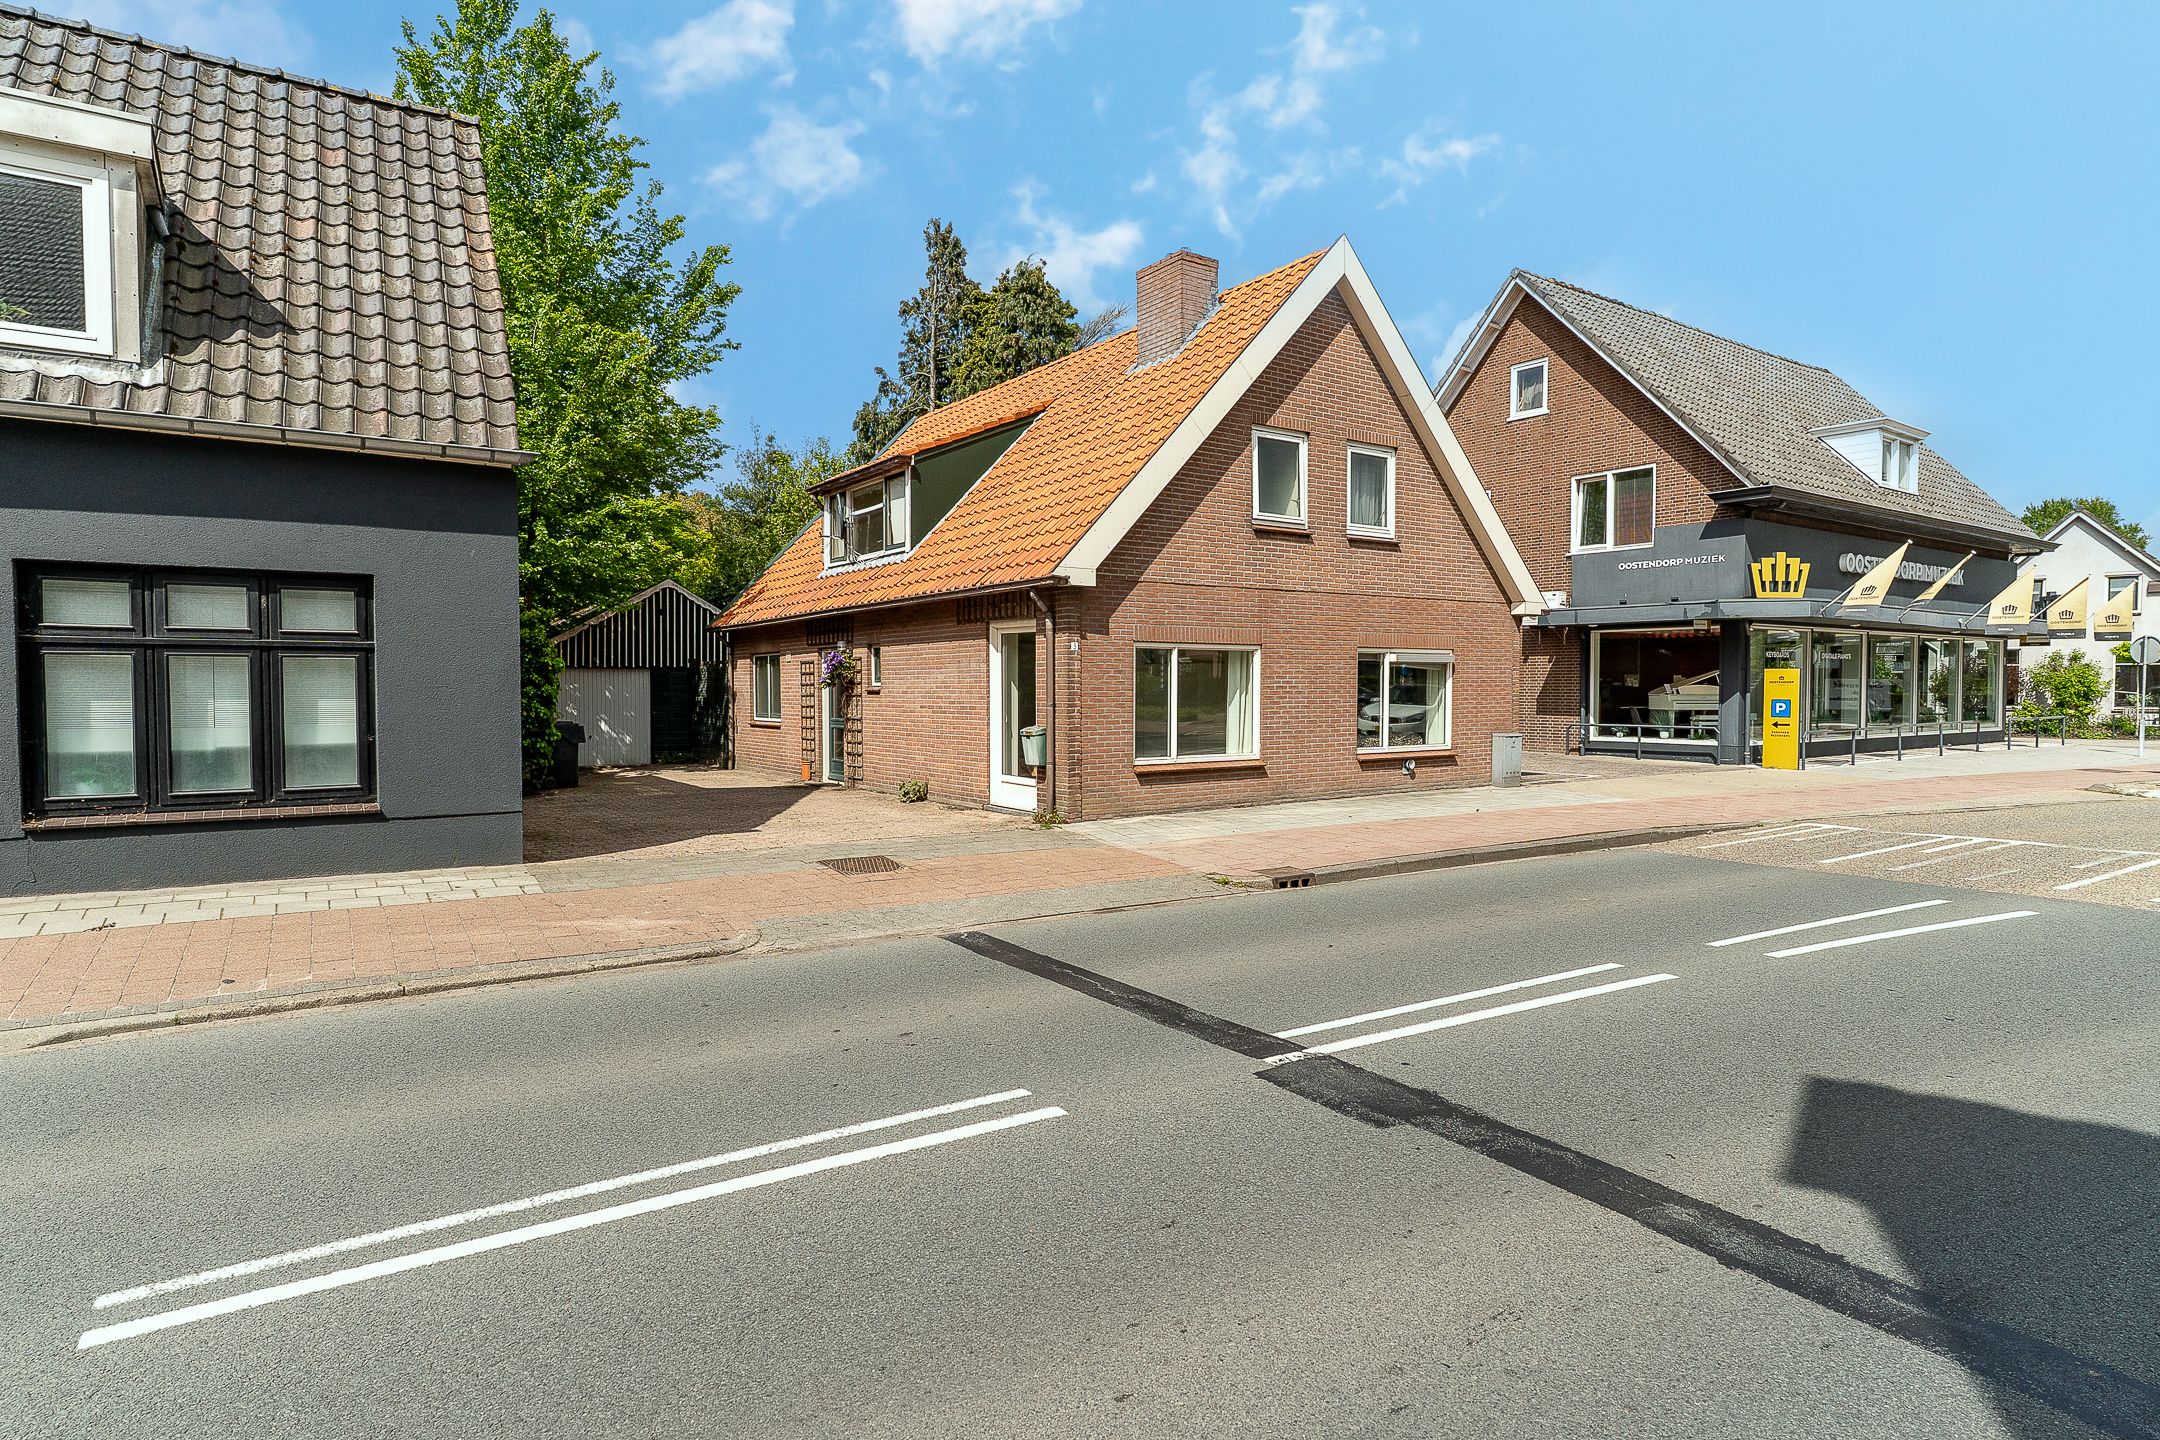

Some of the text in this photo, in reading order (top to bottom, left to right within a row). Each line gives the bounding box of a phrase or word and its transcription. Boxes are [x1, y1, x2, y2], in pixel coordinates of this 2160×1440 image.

[1618, 554, 1726, 571] OOSTENDORP MUZIEK
[1839, 552, 1965, 586] OOSTORP MUZEK
[1775, 702, 1787, 714] P
